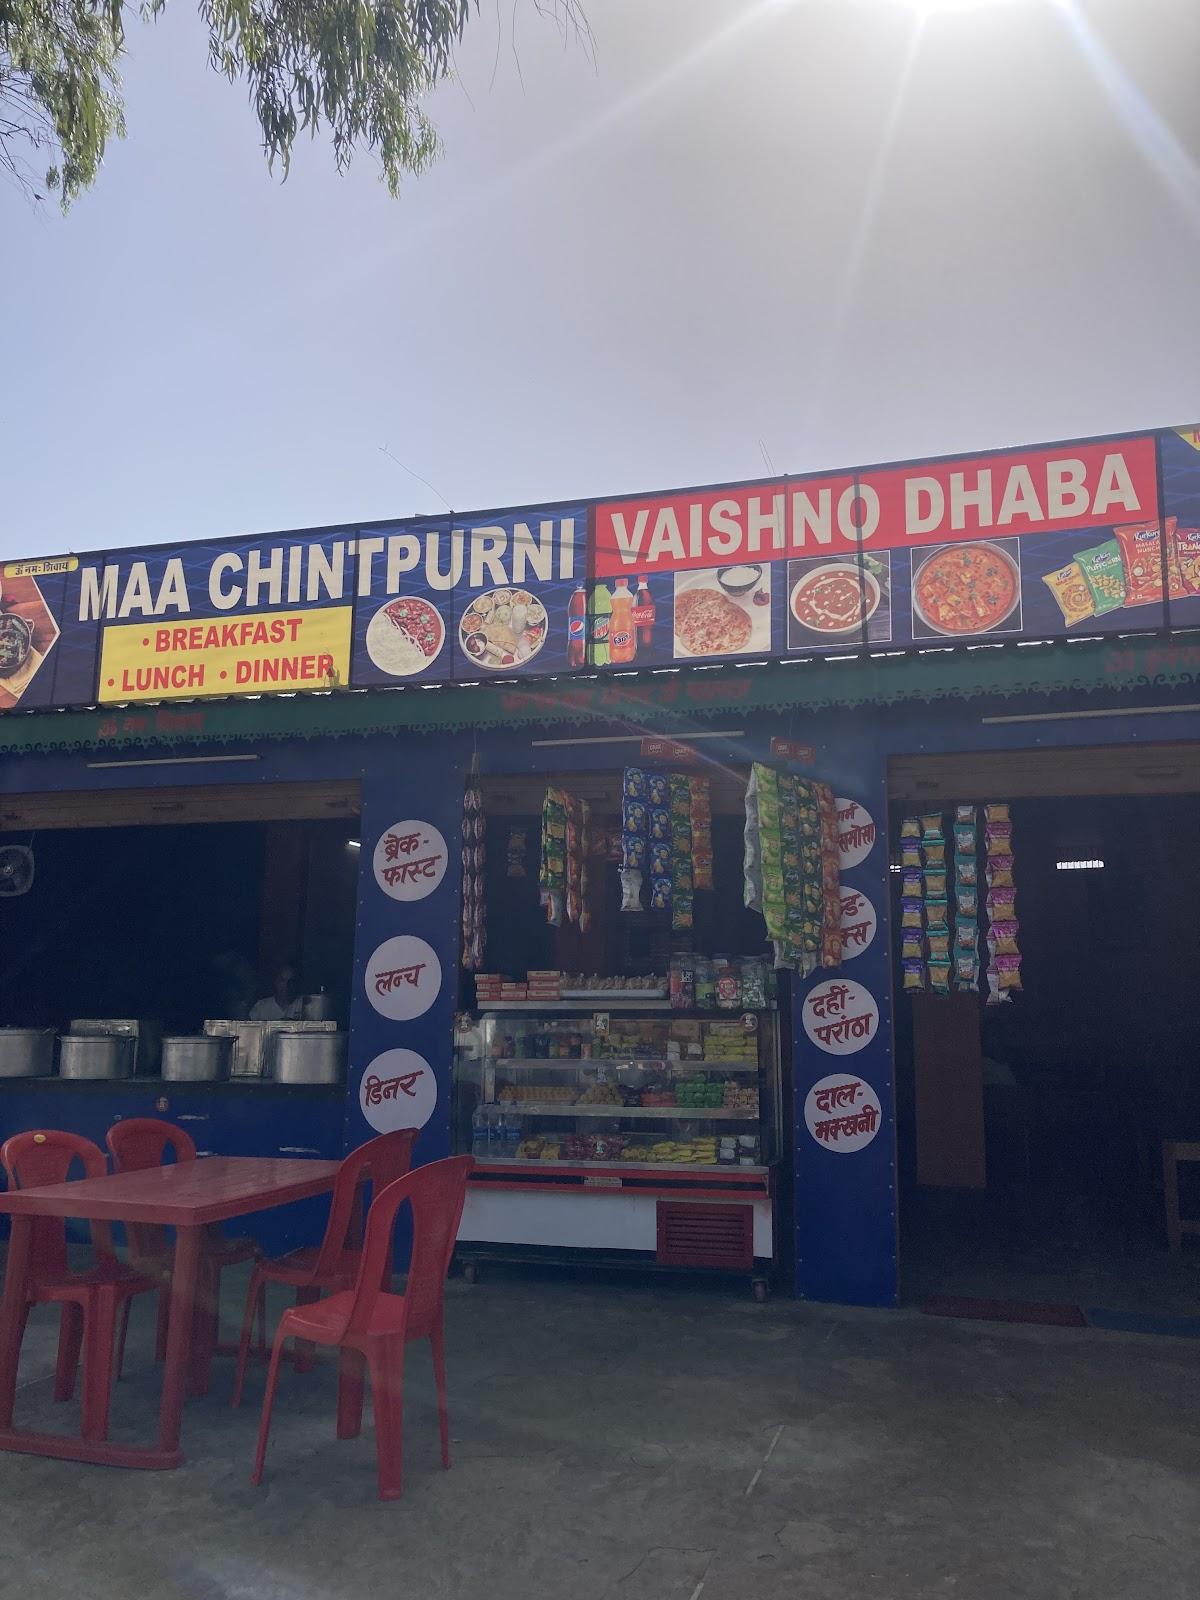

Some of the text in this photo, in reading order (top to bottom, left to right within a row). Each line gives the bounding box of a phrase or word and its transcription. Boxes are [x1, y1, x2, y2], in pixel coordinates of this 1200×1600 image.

[611, 453, 1141, 566] VAISHNO DHABA
[43, 559, 69, 573] शिवाय
[78, 518, 576, 621] MAA CHINTPURNI
[155, 618, 303, 653] BREAKFAST
[122, 654, 335, 692] LUNCH DINNER
[381, 854, 442, 887] फास्ट
[375, 963, 427, 997] लन्च
[813, 1012, 874, 1046] परांठा
[365, 1069, 425, 1107] डिनर
[814, 1104, 881, 1143] मक्खनी
